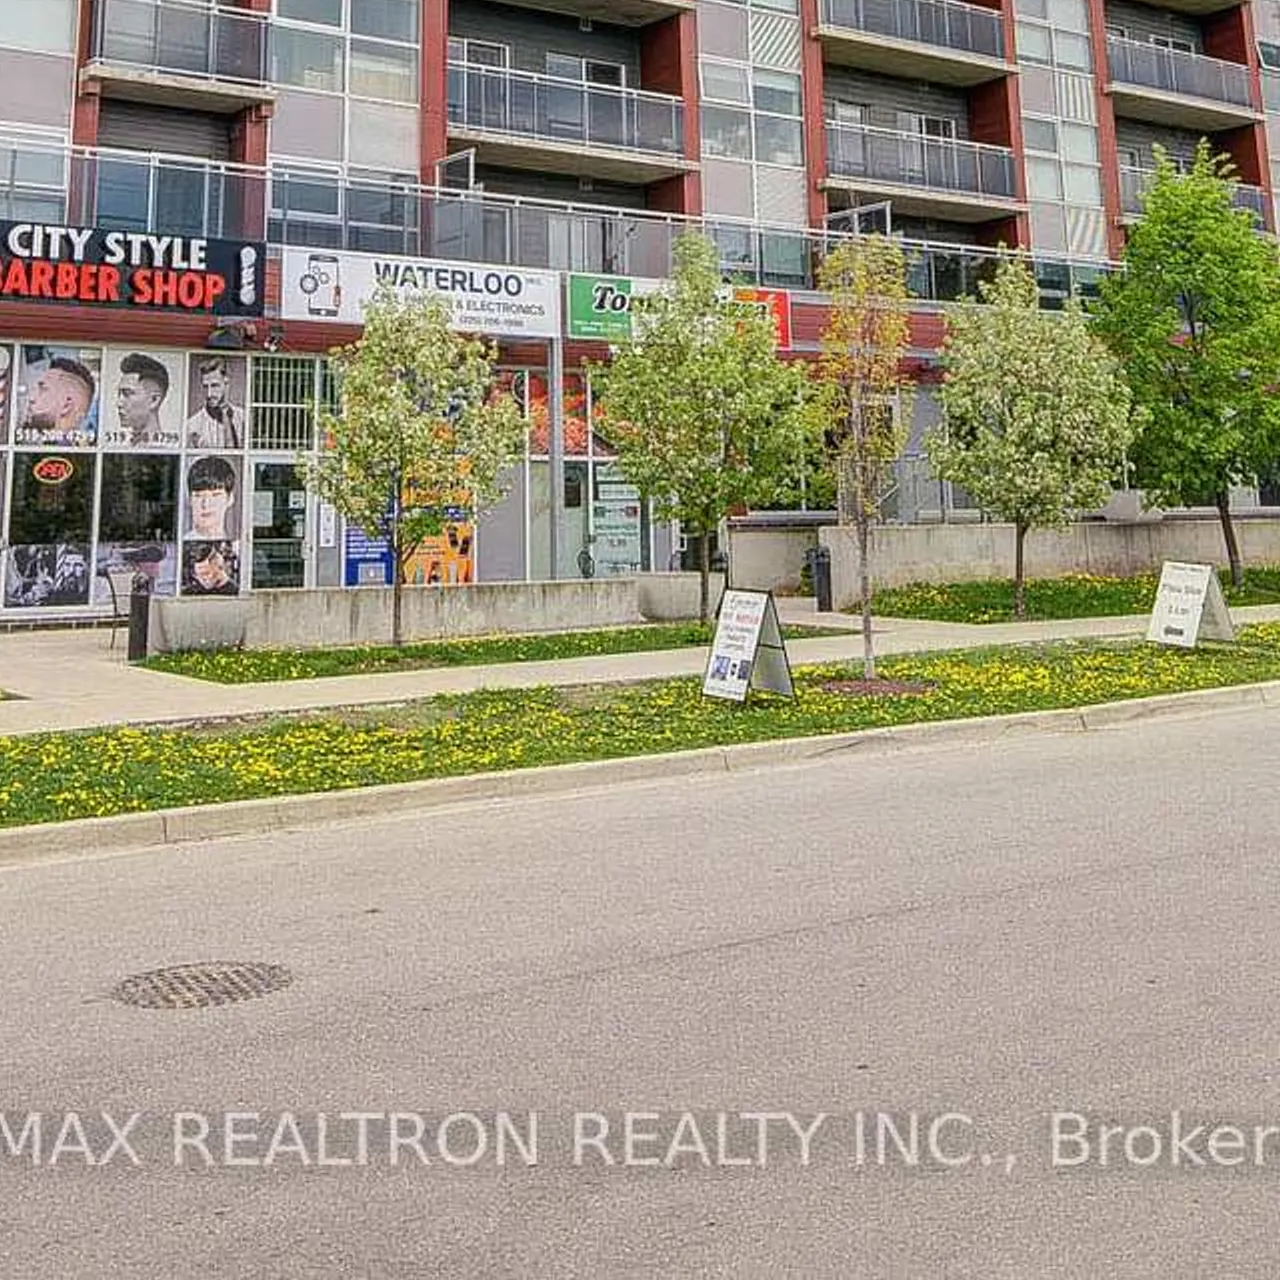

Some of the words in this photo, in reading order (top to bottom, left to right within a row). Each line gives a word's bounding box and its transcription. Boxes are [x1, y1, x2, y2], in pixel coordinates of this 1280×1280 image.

[7, 223, 93, 260] CITY
[104, 231, 208, 270] STYLE
[132, 267, 226, 309] SHOP
[374, 261, 523, 297] WATERLOO
[465, 299, 546, 317] ELECTRONICS
